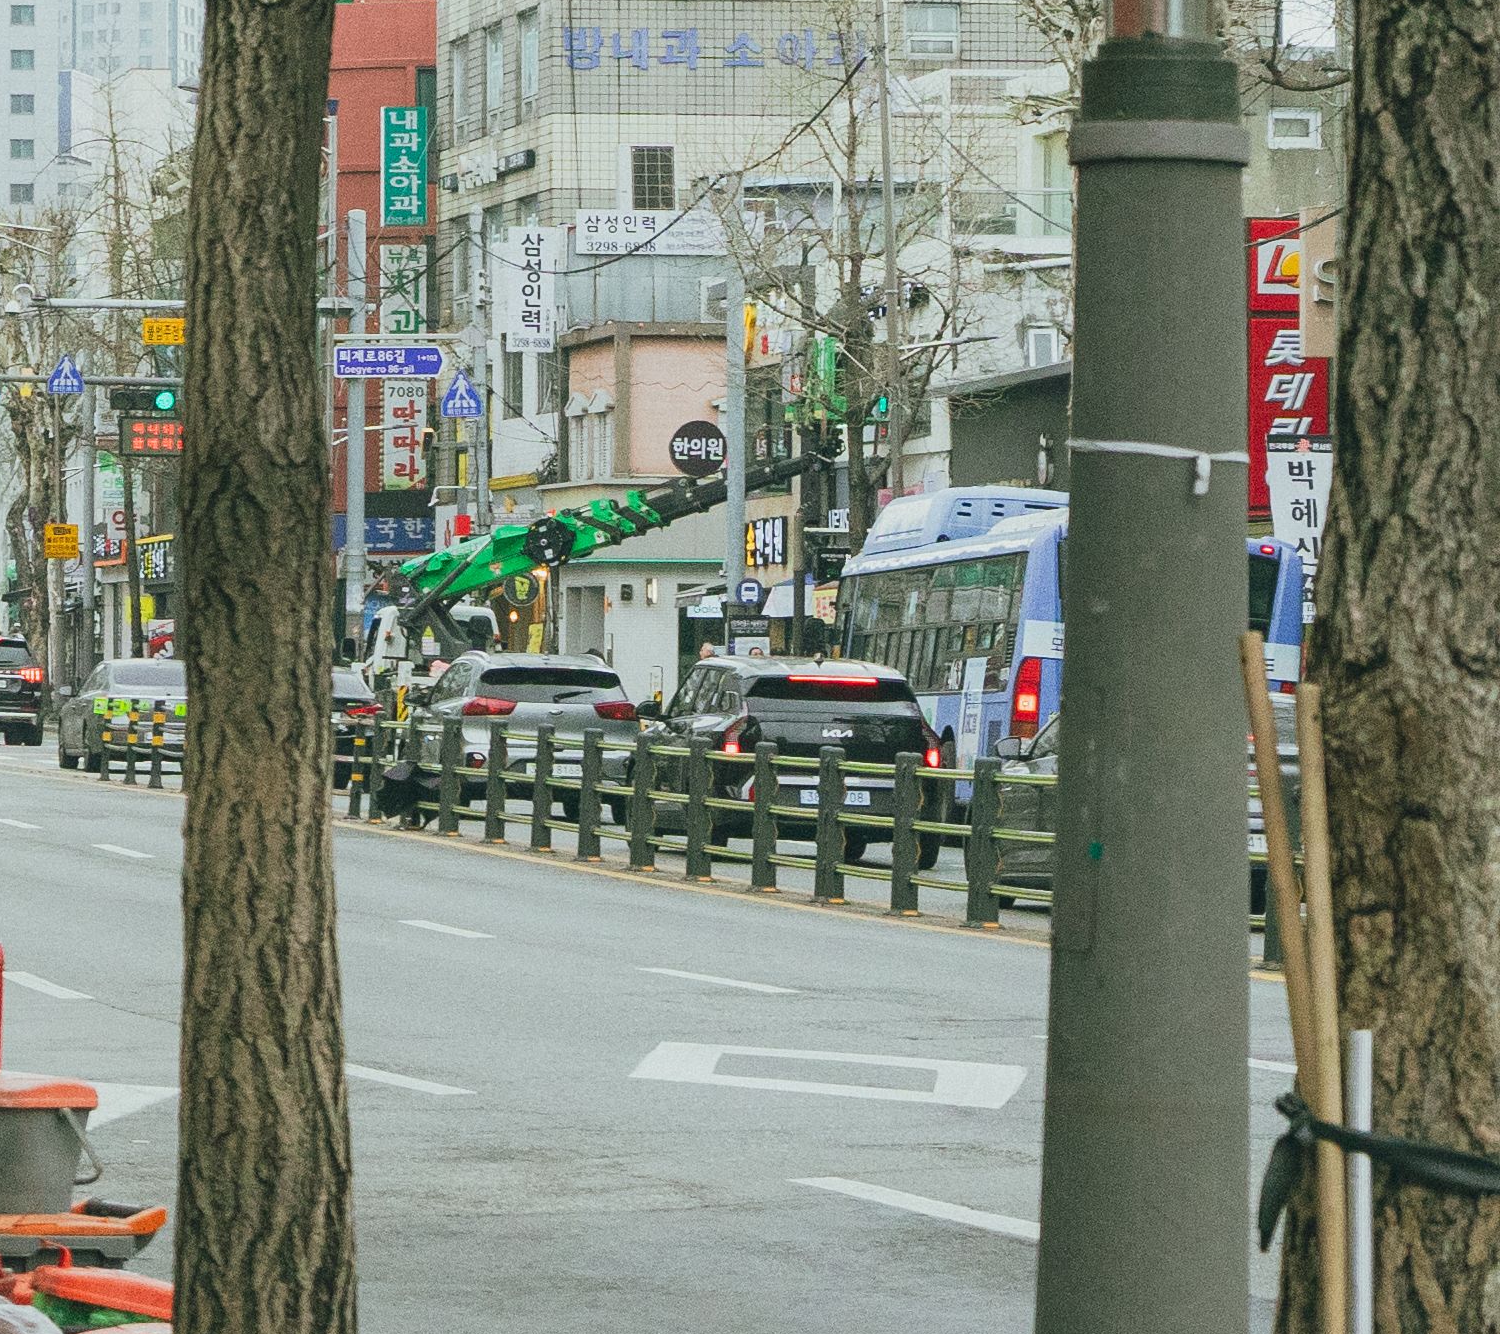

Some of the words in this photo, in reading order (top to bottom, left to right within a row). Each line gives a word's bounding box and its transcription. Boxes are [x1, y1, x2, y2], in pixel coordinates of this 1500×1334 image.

[584, 214, 657, 234] 삼성인력
[521, 232, 545, 334] 삼성인력
[338, 349, 406, 364] 퇴계로86길
[388, 386, 425, 398] 7080
[672, 437, 724, 461] 한의원
